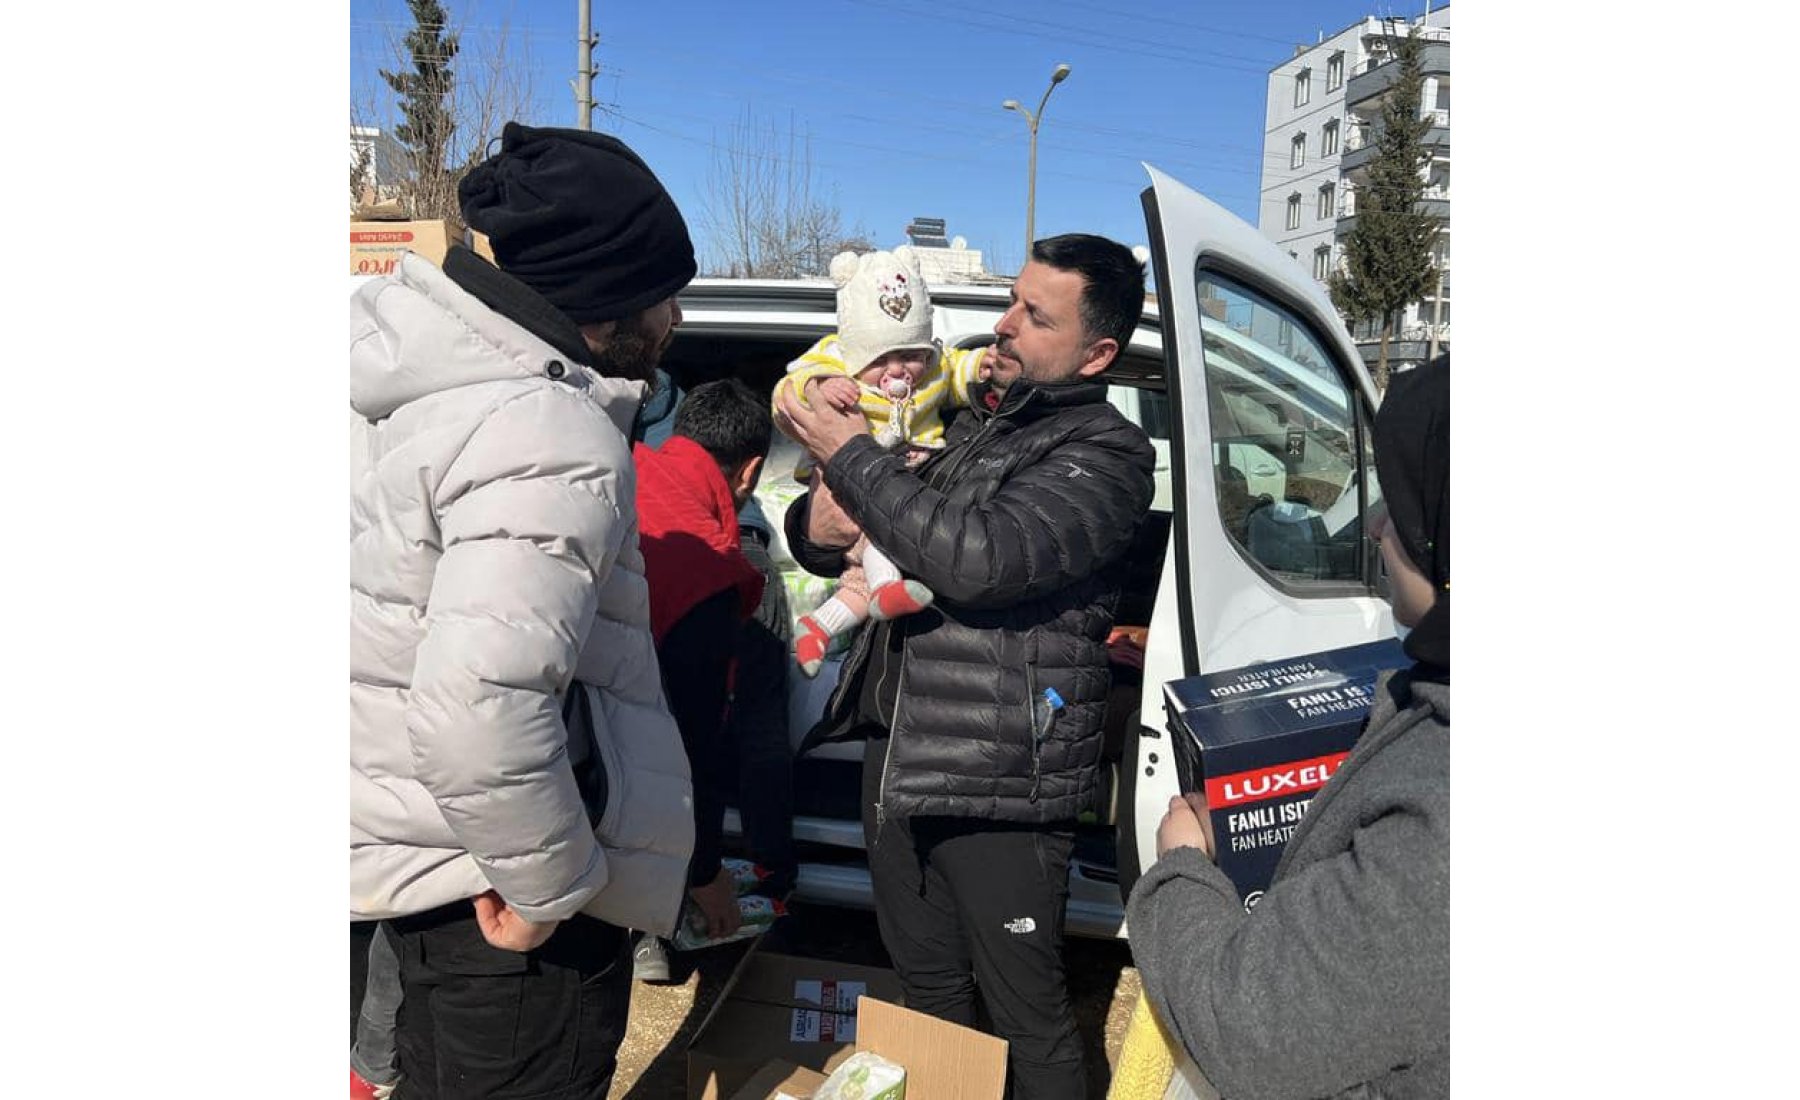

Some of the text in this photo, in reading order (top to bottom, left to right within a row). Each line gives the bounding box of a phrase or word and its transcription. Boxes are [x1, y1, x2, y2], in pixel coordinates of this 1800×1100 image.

[1288, 690, 1343, 709] FANLI
[1296, 697, 1375, 719] FAN HEATE
[1224, 761, 1343, 800] LUXEL
[1228, 799, 1313, 833] FANLI ISIT
[1231, 825, 1294, 853] FAN HEATE
